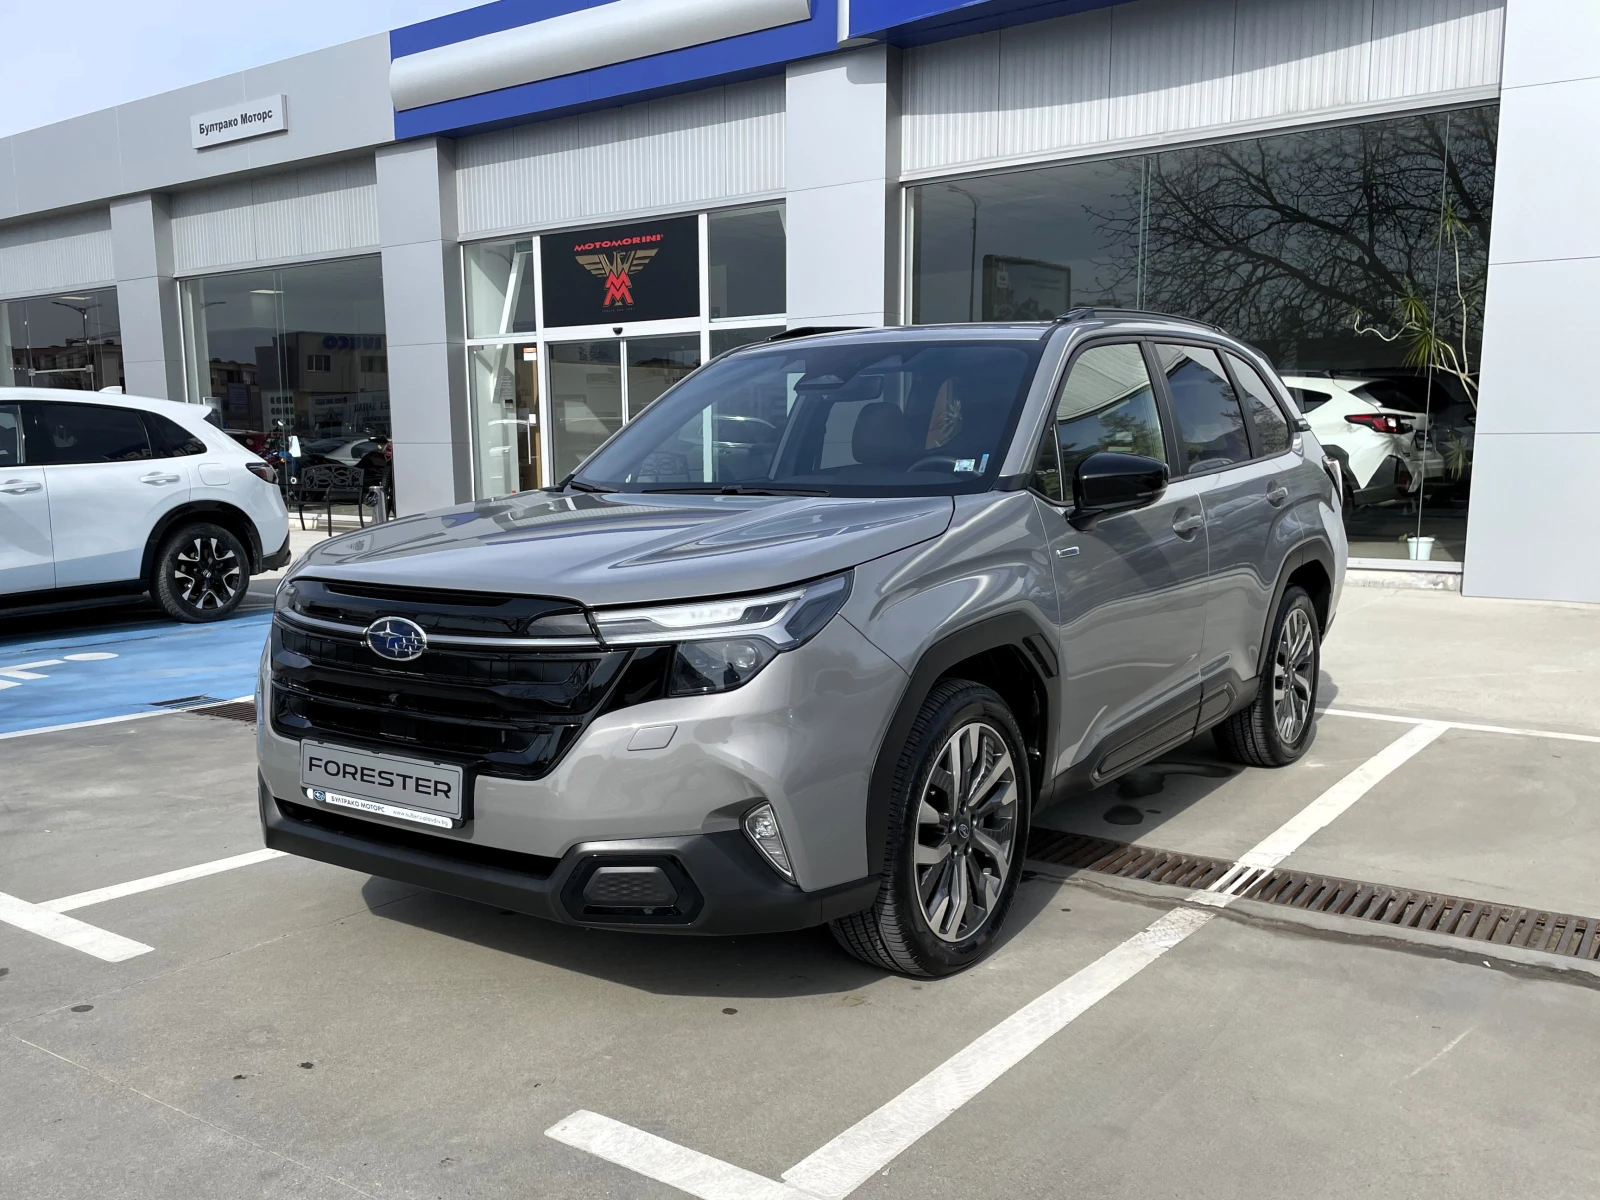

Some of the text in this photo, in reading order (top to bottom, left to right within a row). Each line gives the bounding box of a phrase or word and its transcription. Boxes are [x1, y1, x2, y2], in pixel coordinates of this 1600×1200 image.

[199, 109, 273, 136] Бултрако Моторс
[573, 233, 662, 252] MOTOMORINI
[308, 756, 452, 798] FORESTER
[360, 802, 386, 813] МОТОРС
